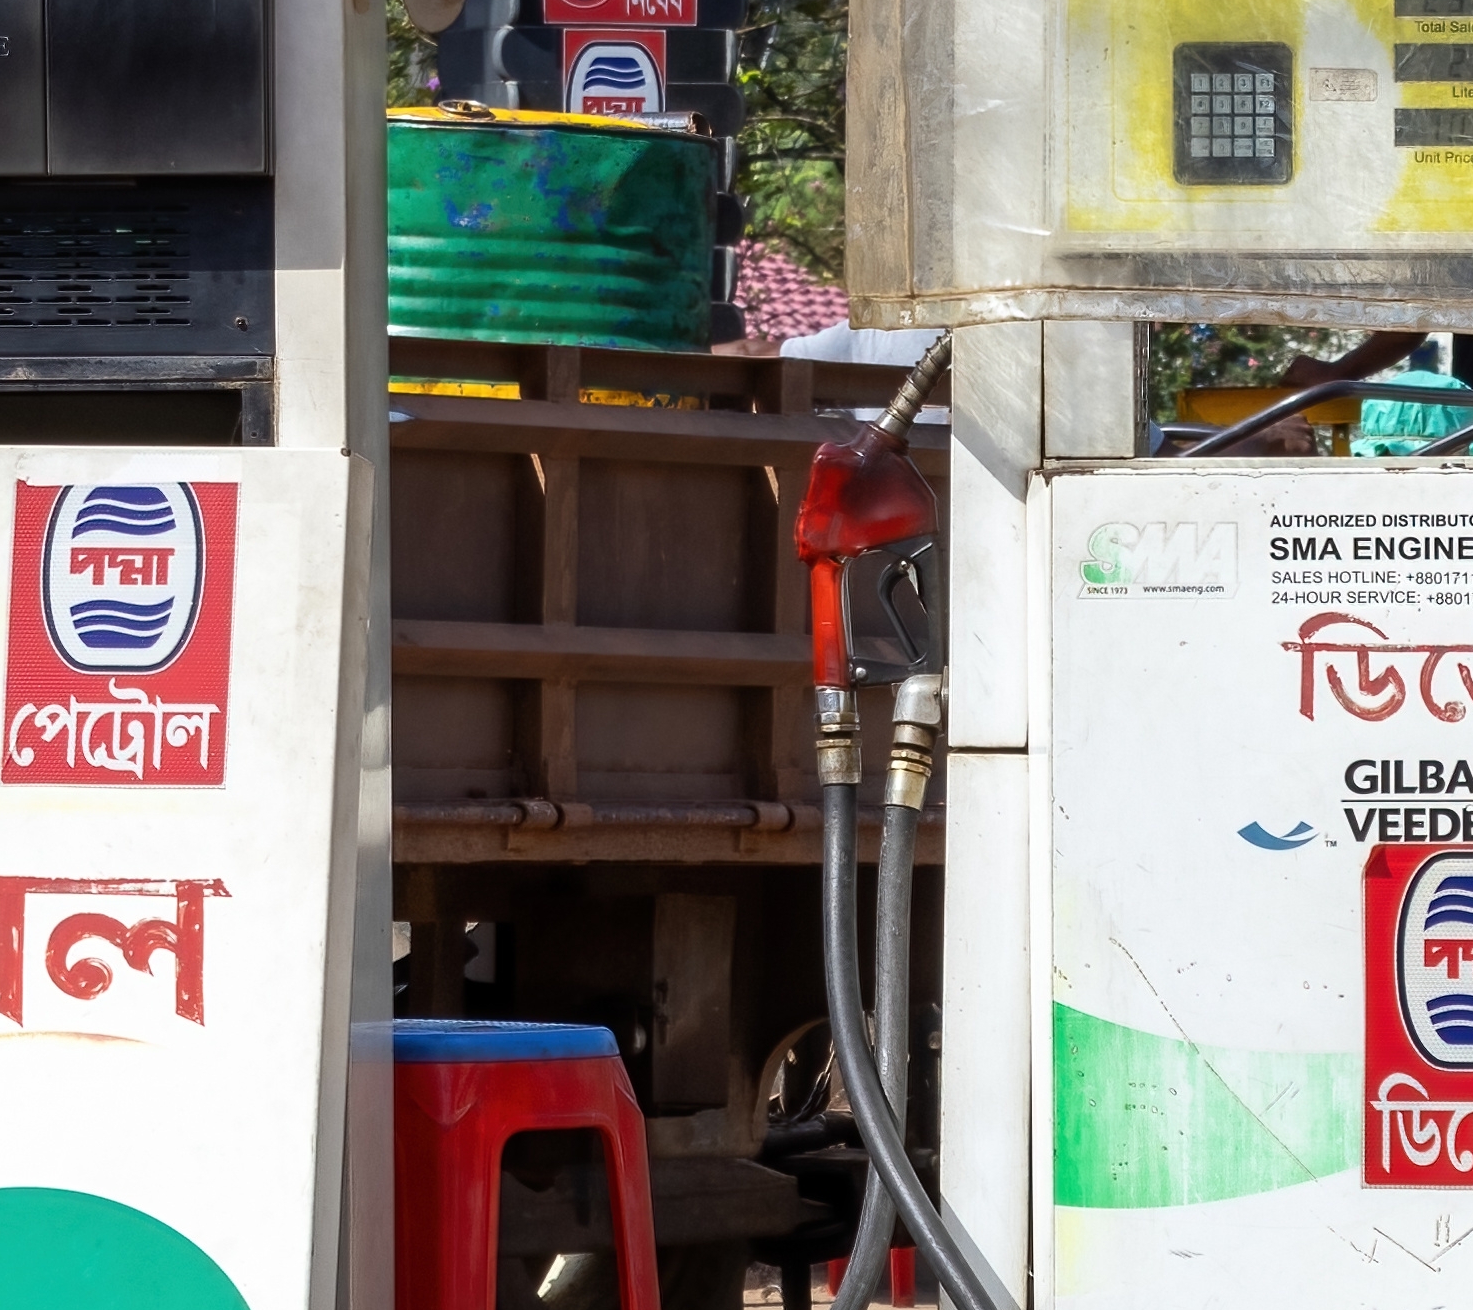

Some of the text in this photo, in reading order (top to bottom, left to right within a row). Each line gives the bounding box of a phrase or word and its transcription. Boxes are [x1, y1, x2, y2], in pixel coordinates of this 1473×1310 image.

[1416, 21, 1446, 33] Total
[1414, 152, 1441, 164] Unit
[1270, 514, 1377, 527] AUTHORIZED
[1270, 537, 1343, 561] SMA
[70, 547, 175, 586] পদ্মা
[1271, 571, 1323, 584] SALES
[1328, 571, 1402, 584] HOTLINE:
[1087, 586, 1109, 594] SINCE
[1143, 584, 1225, 595] www.smaeng.com
[1271, 591, 1342, 604] 24-HOUR
[1346, 591, 1421, 604] SERVICE:
[8, 677, 222, 781] পেট্রোল
